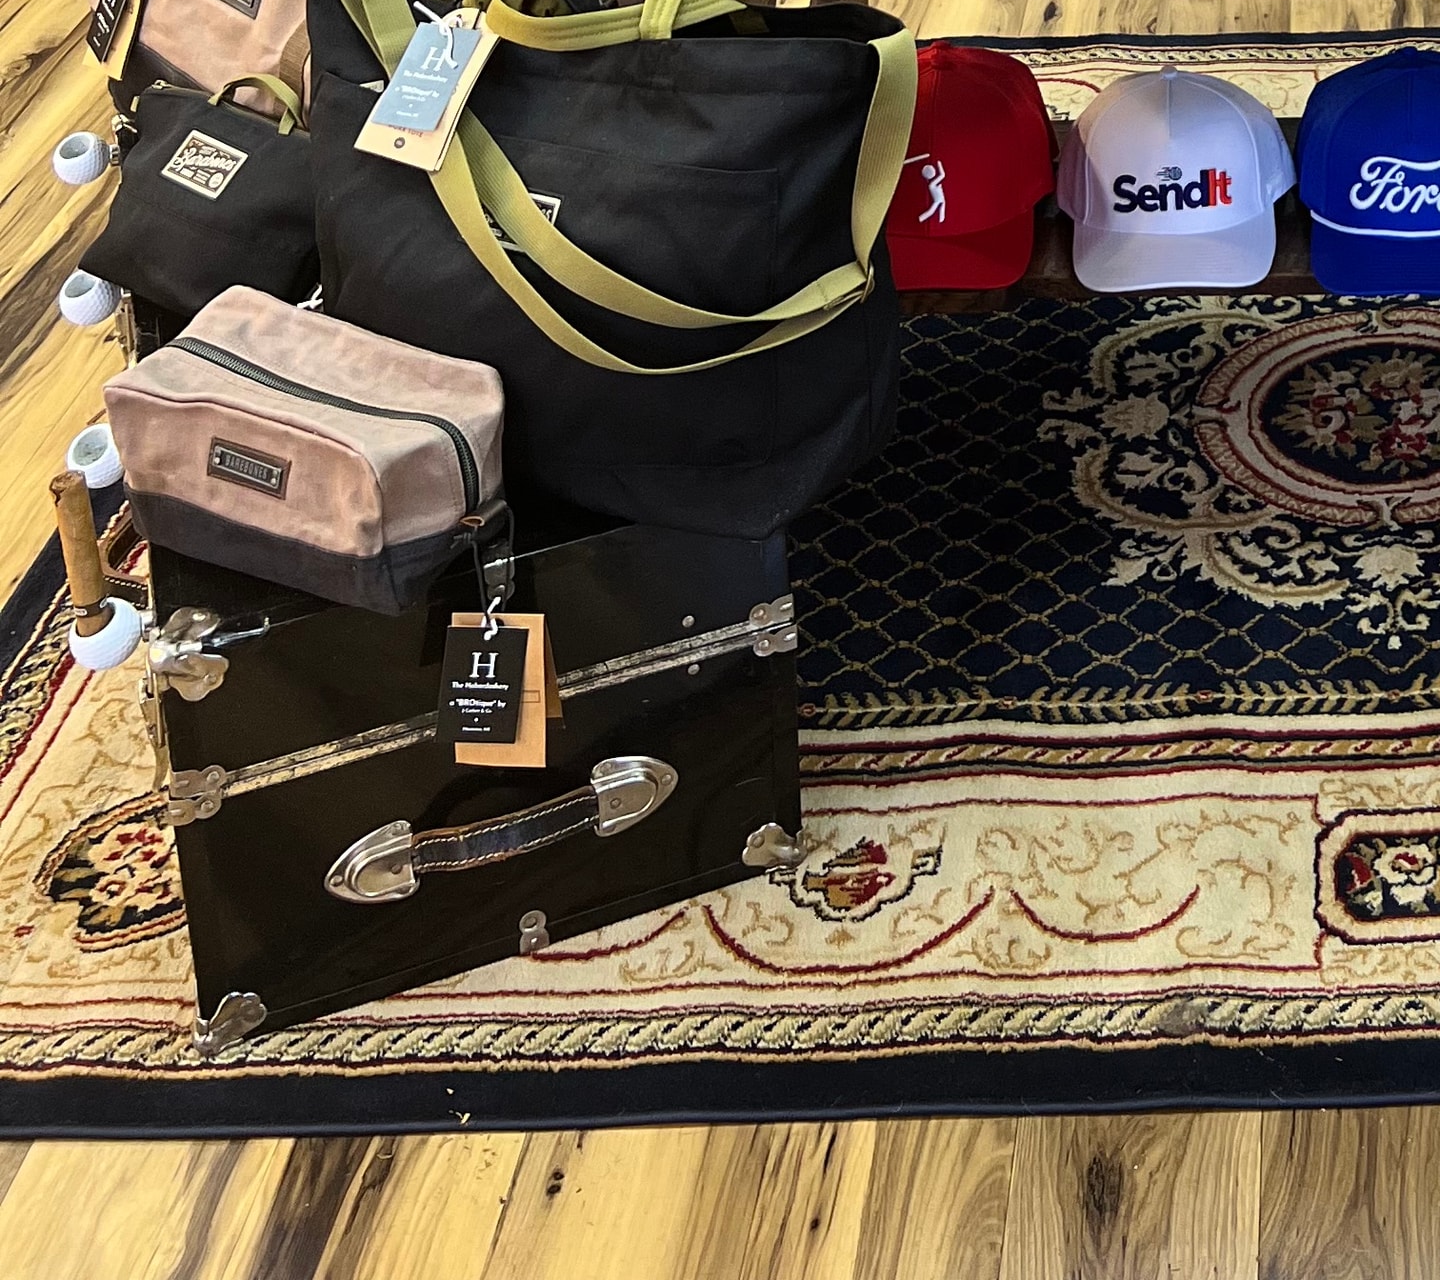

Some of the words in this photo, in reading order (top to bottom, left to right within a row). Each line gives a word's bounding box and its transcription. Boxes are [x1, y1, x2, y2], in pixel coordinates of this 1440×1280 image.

[420, 46, 448, 72] H
[225, 454, 269, 480] BAREBONES
[469, 651, 499, 678] H
[452, 681, 464, 689] The
[497, 699, 507, 708] by
